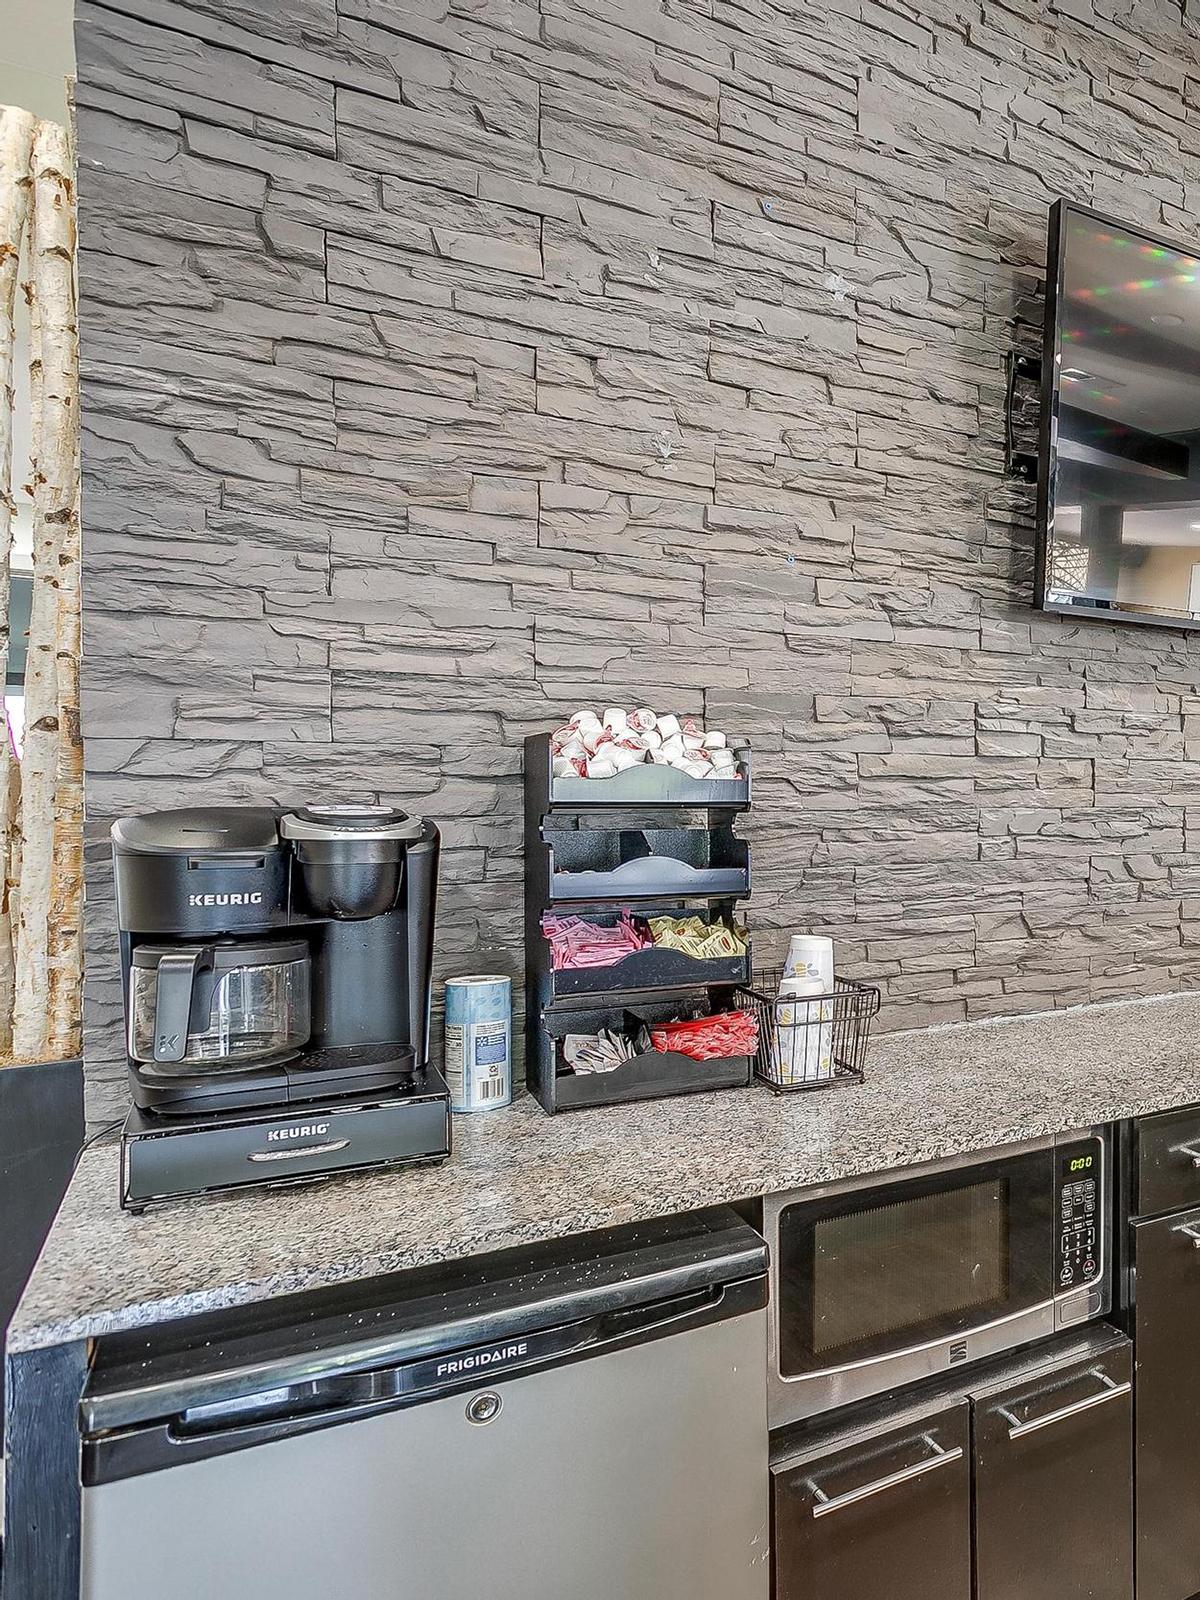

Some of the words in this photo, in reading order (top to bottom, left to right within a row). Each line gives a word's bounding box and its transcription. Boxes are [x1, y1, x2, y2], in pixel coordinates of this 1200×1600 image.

[188, 892, 262, 906] KEURIG
[267, 1122, 329, 1142] KEURIG
[1070, 1156, 1093, 1171] 0:00
[436, 1343, 528, 1376] FRIGIDAIRE
